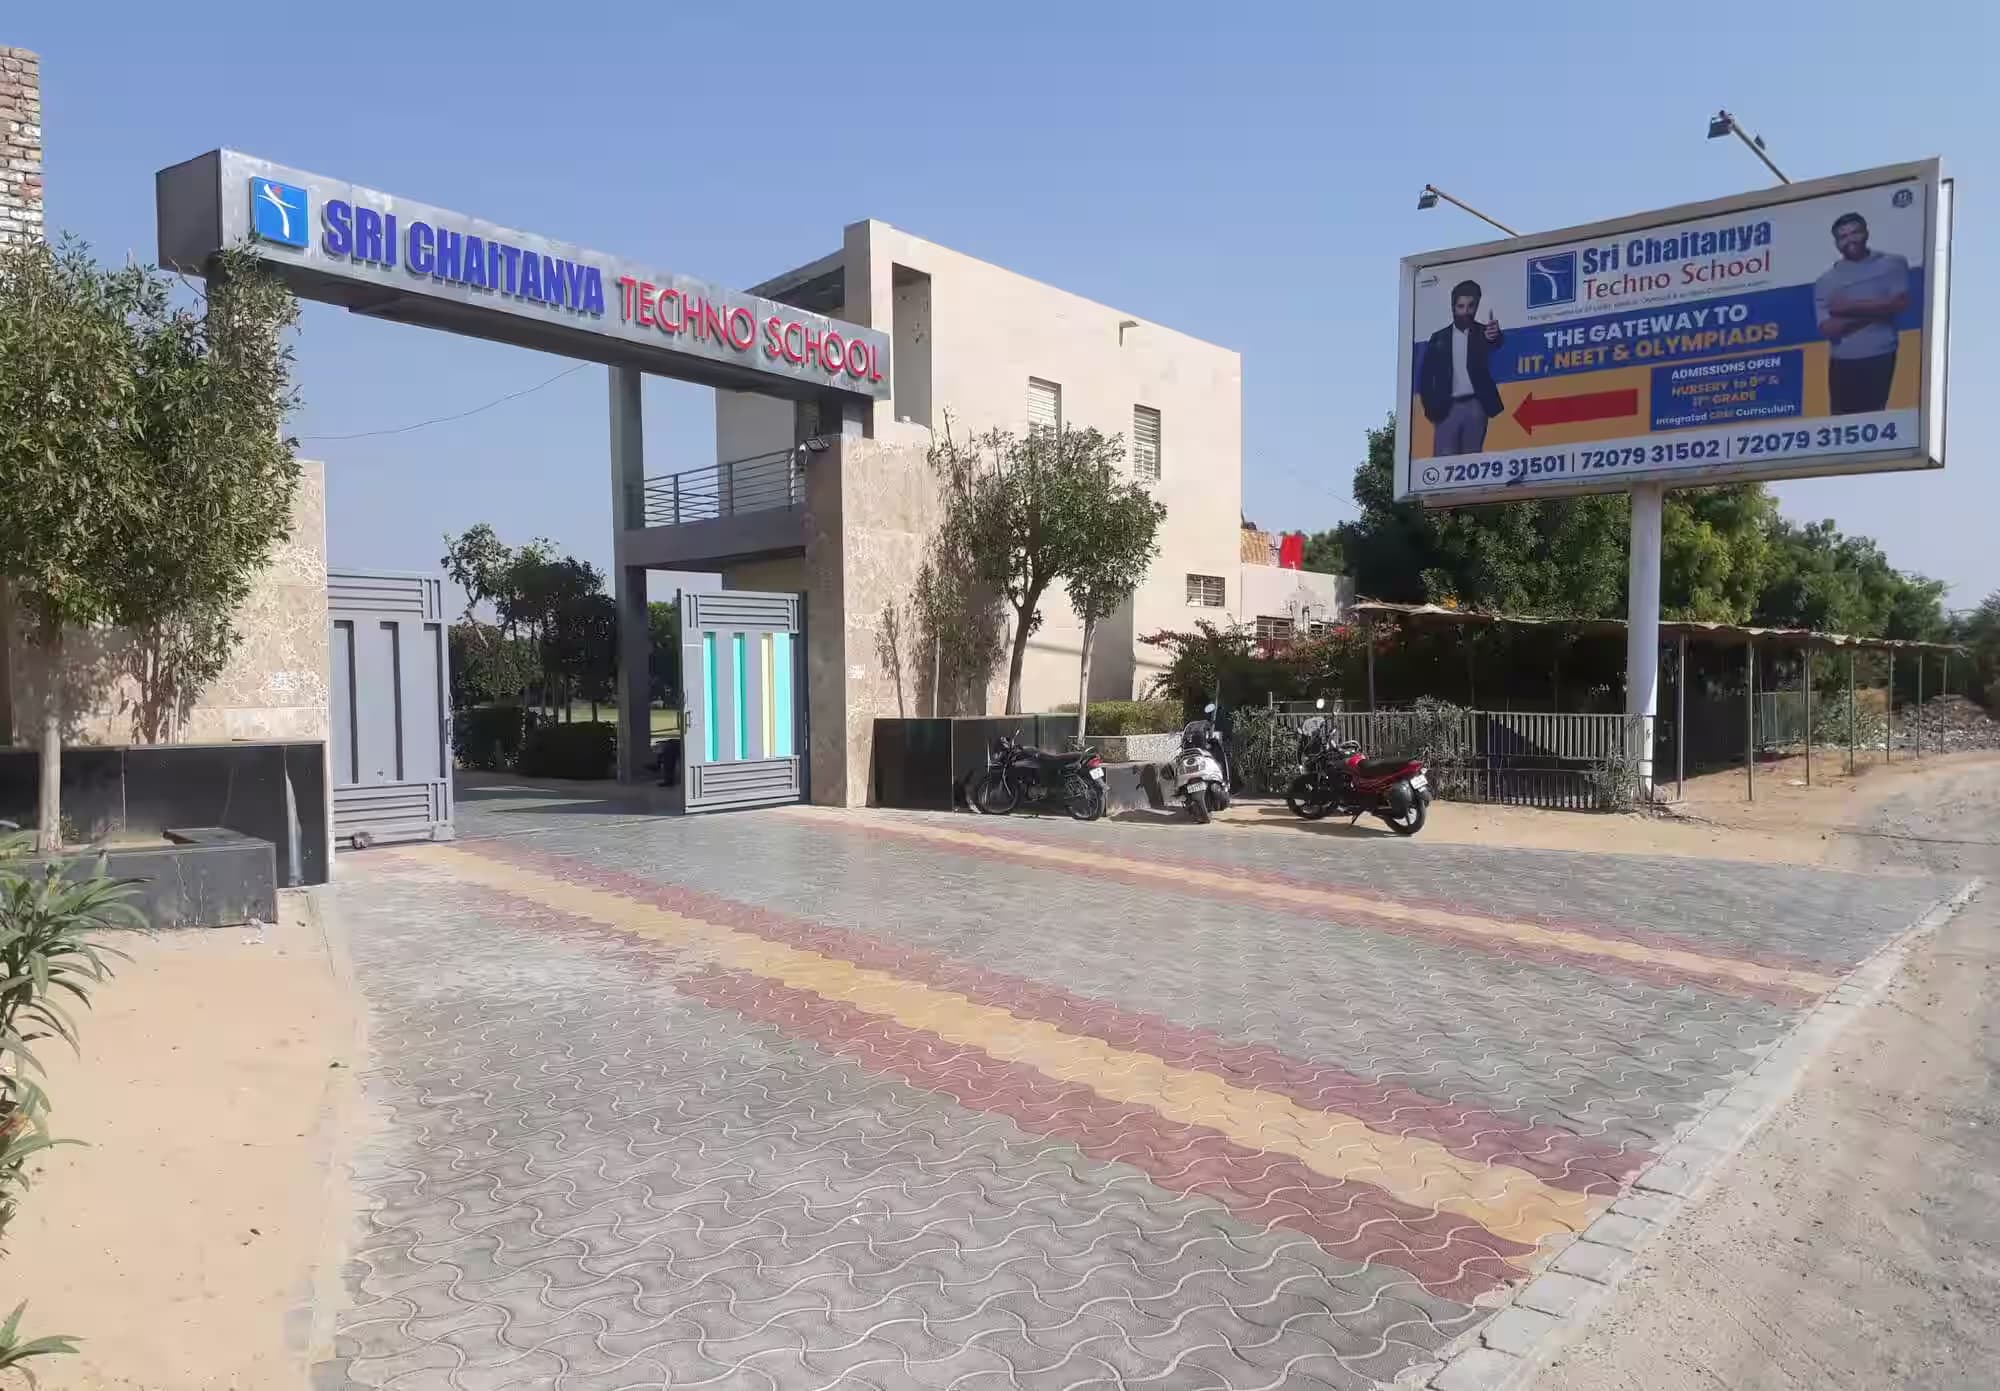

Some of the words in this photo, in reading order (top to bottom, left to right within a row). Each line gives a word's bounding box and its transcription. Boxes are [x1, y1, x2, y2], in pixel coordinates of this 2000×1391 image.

[323, 199, 397, 268] SRI
[406, 220, 605, 316] CHAITANYA
[1582, 244, 1620, 275] Sri
[1626, 220, 1772, 267] Chaitanya
[1583, 272, 1671, 300] Techno
[1681, 250, 1770, 285] School
[619, 275, 757, 350] TECHNO
[764, 316, 883, 382] SCHOOL
[1517, 354, 1550, 375] IIT,
[1554, 346, 1606, 370] NEET
[1612, 343, 1630, 362] &
[1635, 322, 1779, 358] OLYMPIADS
[1544, 329, 1585, 349] THE
[1589, 308, 1710, 342] GATEWAY
[1713, 304, 1749, 325] TO
[1671, 361, 1746, 380] ADMISSIONS
[1747, 356, 1782, 370] OPEN
[1671, 381, 1728, 397] NURSERY
[1656, 412, 1707, 426] Integrated
[1736, 403, 1795, 417] Curriculum
[1712, 390, 1757, 404] GRADE
[1444, 461, 1503, 482] 72079
[1508, 454, 1566, 476] 31501
[1580, 447, 1646, 470] 72079
[1651, 439, 1720, 462] 31502
[1736, 430, 1810, 455] 72079
[1816, 421, 1897, 447] 31504
